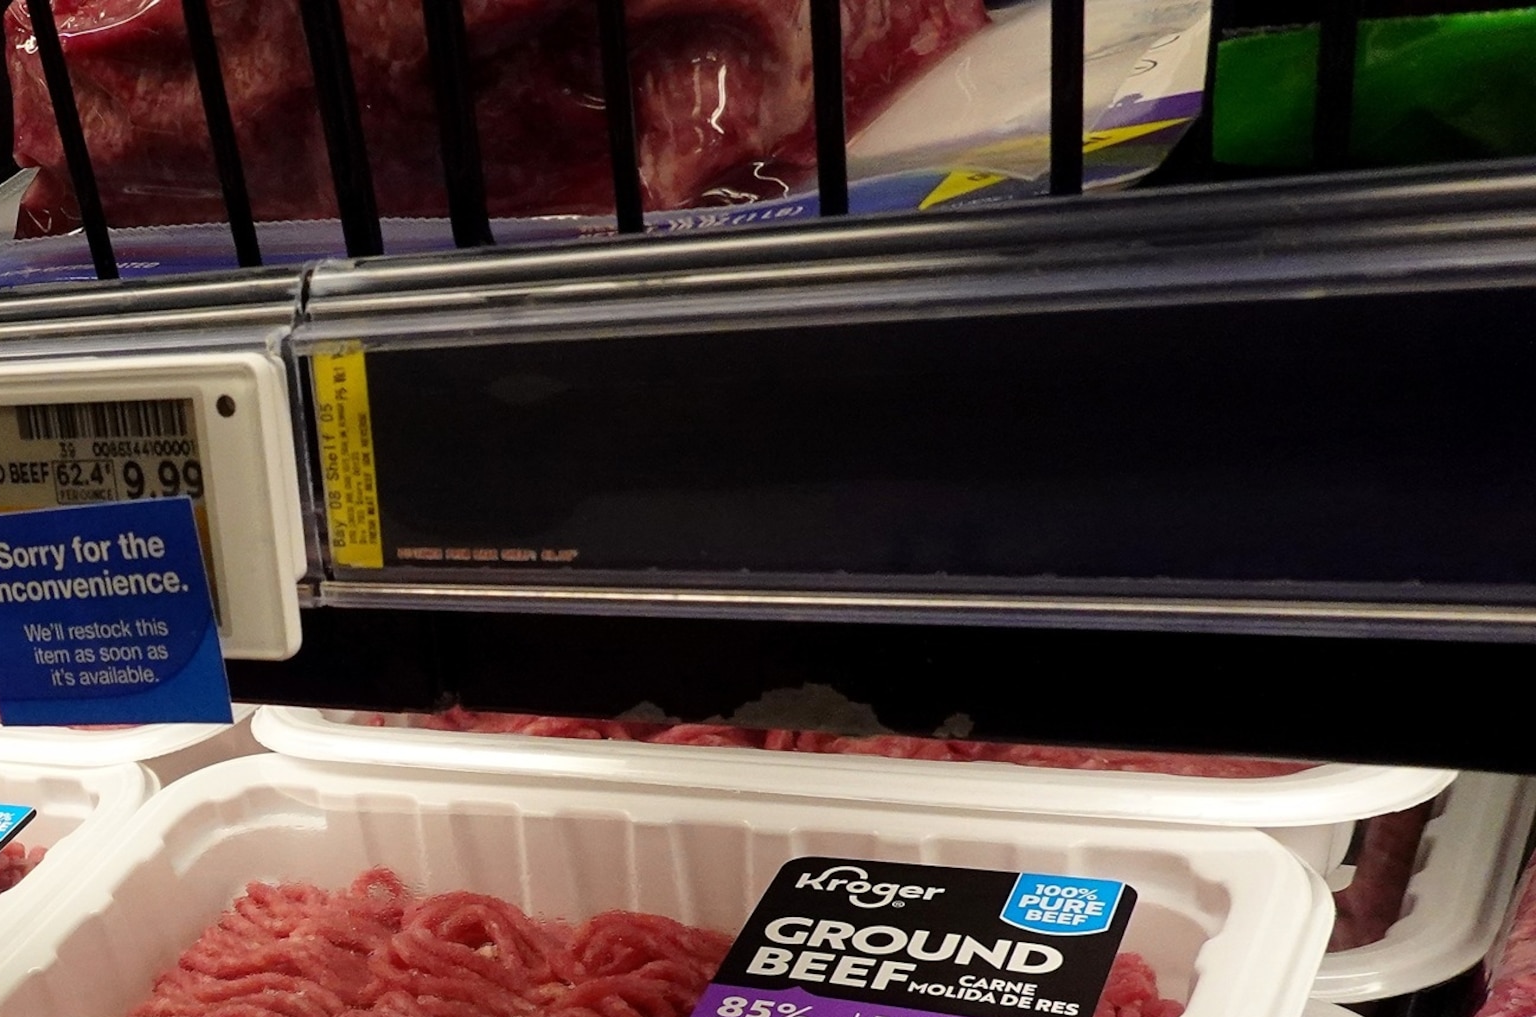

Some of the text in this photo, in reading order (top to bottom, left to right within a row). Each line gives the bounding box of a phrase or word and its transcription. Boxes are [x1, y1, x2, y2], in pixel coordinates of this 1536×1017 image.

[9, 461, 50, 484] BEEF
[122, 460, 204, 499] 9.99
[321, 402, 347, 547] Bay 08 Shelf 05
[72, 536, 111, 563] for
[118, 531, 165, 560] the
[24, 618, 169, 643] We'll restock this
[34, 644, 169, 665] item as soon as
[51, 665, 160, 686] it's available.
[794, 866, 946, 909] Kroger
[1034, 883, 1098, 902] 100%
[1018, 894, 1106, 917] PURE
[1024, 909, 1089, 926] BEEF
[764, 916, 1064, 974] GROUND
[746, 946, 917, 992] BEEF
[908, 981, 1080, 1017] MOLIDA DE RES
[958, 975, 1038, 998] CARNE
